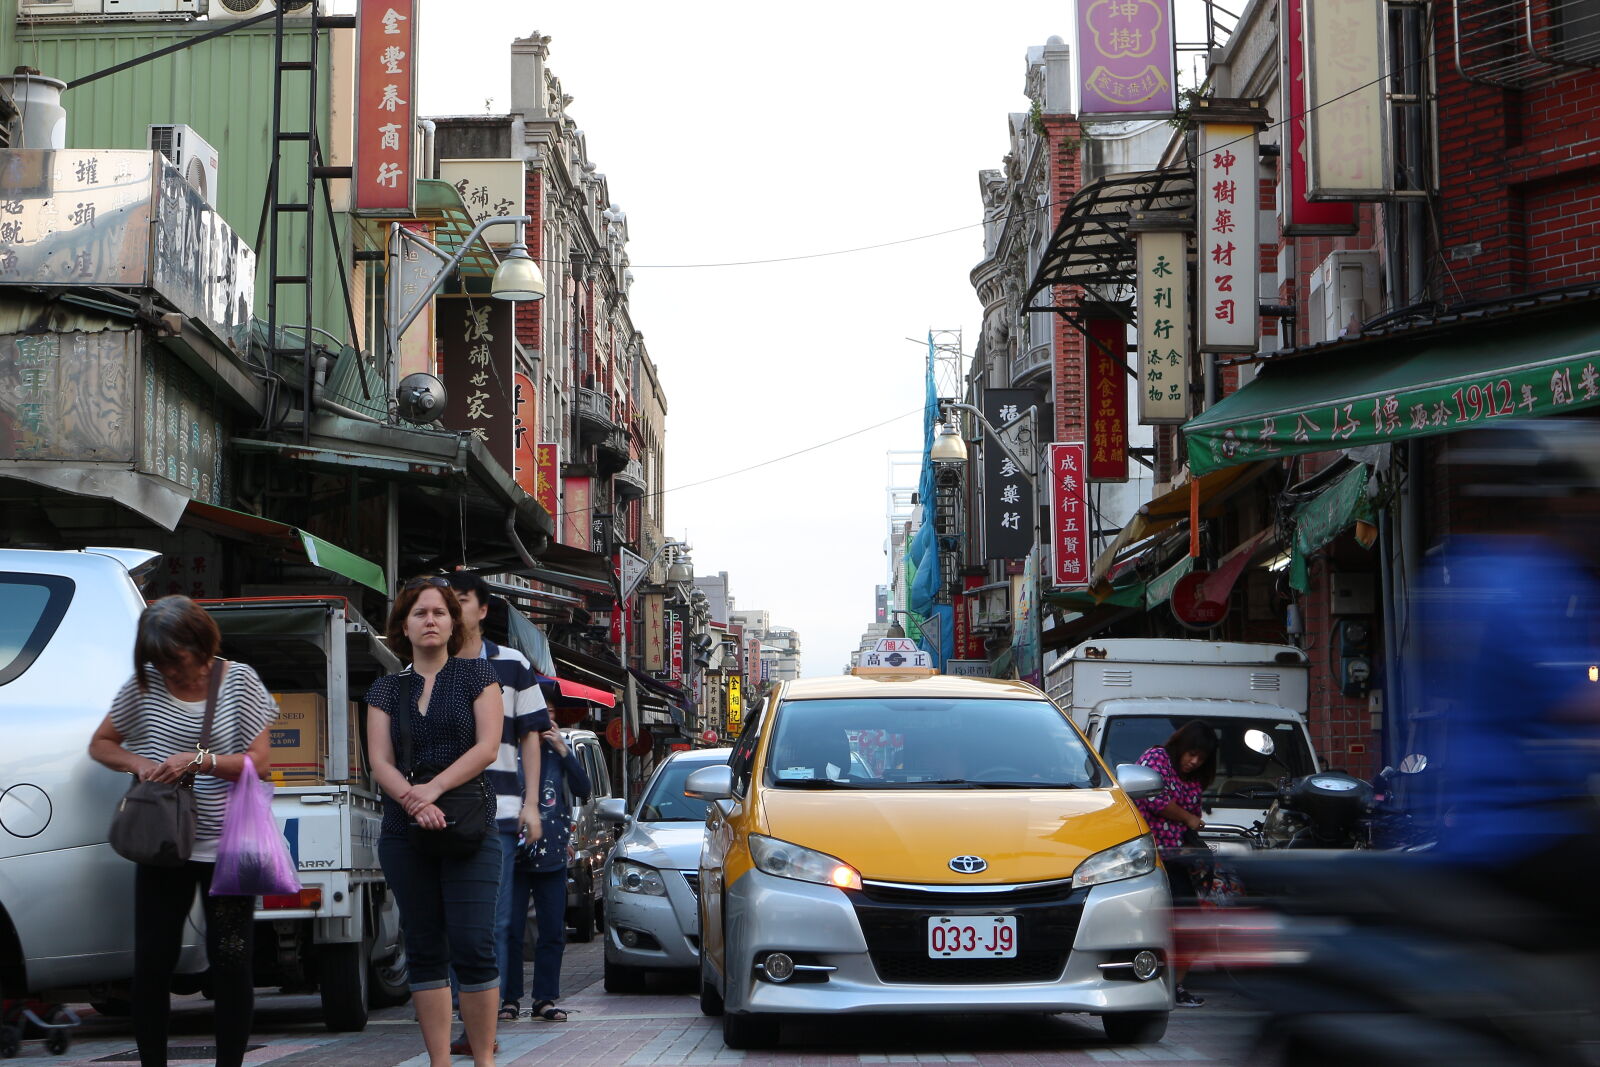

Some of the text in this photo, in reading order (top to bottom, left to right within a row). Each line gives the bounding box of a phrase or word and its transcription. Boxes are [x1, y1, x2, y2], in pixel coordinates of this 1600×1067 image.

[1109, 0, 1142, 51] 坤樹
[1211, 150, 1237, 325] 坤樹藥材公司
[1152, 255, 1174, 339] 永利行
[1000, 405, 1020, 530] 福參藥行
[1060, 455, 1081, 574] 成泰行五賢醋
[884, 640, 910, 651] 個人
[282, 712, 305, 720] SEED
[932, 926, 1013, 951] 033-J9
